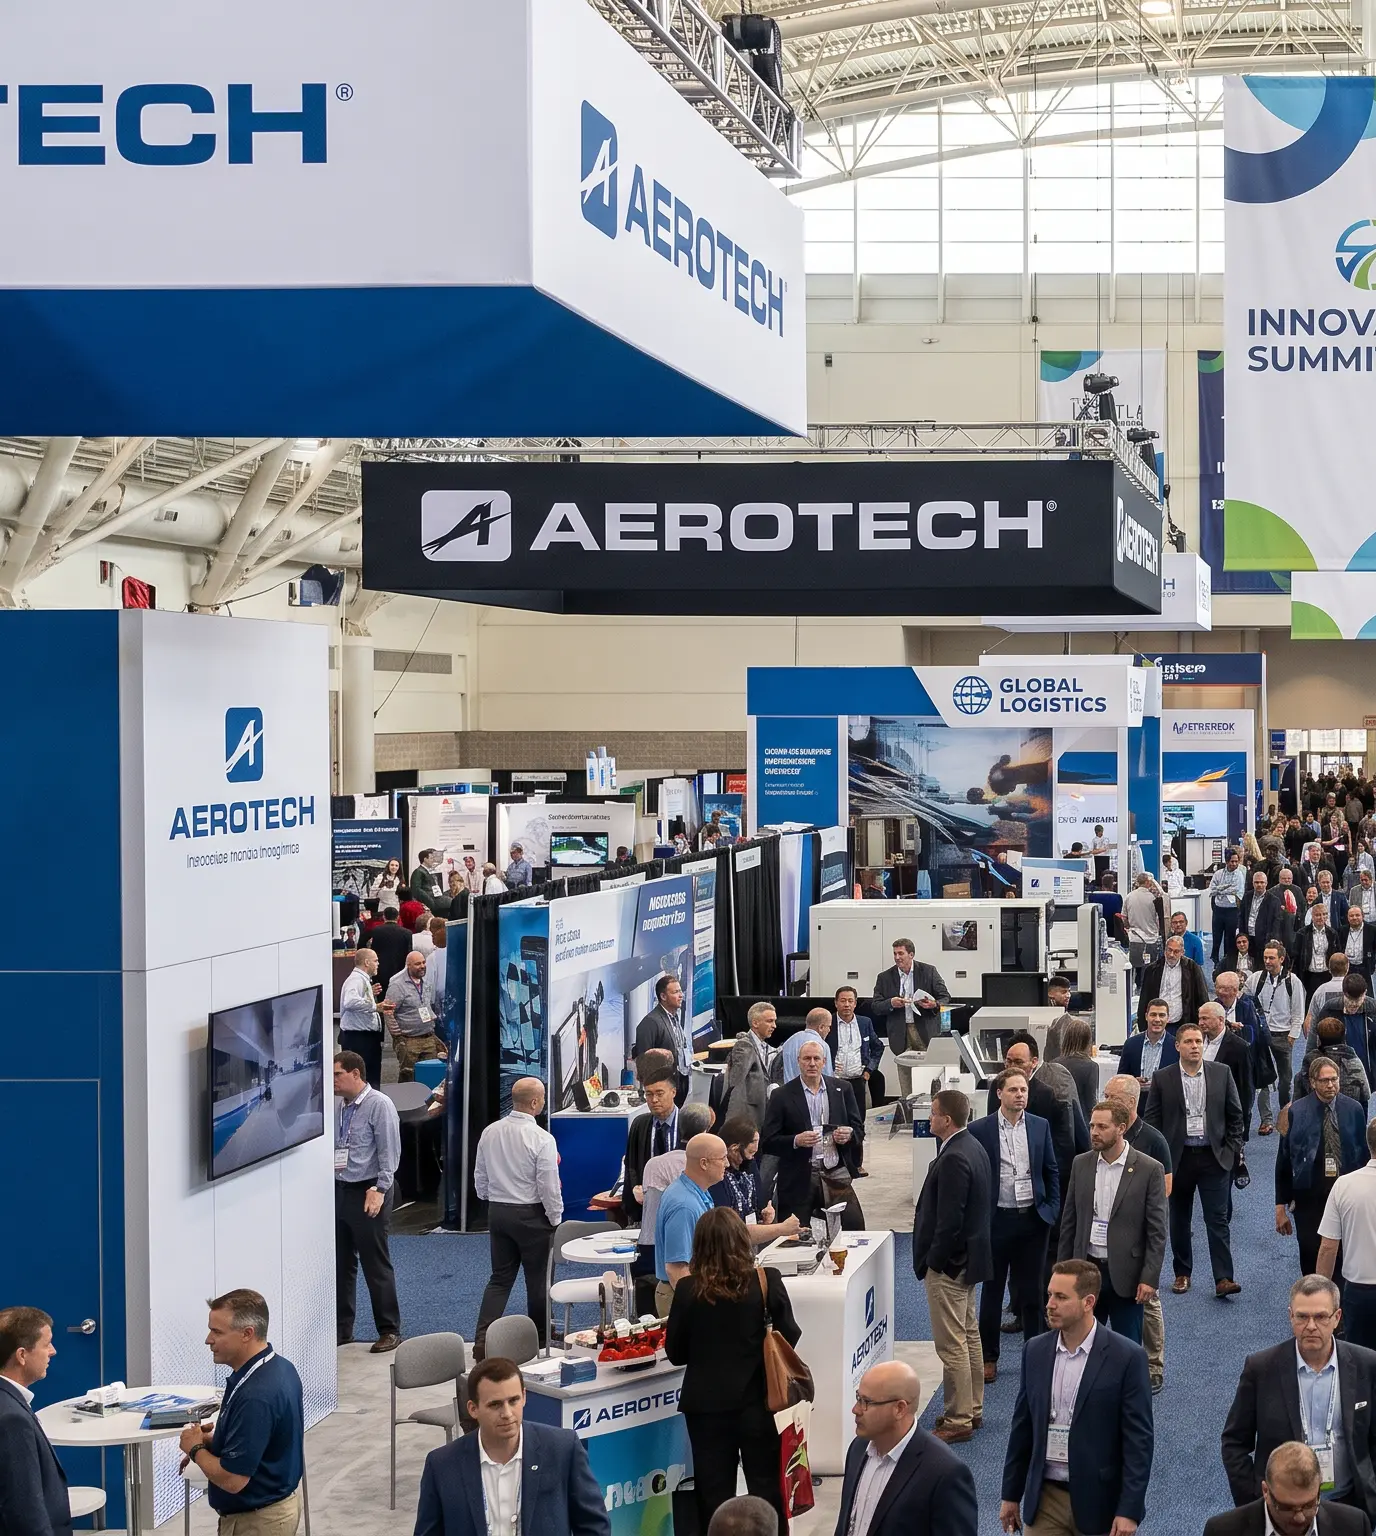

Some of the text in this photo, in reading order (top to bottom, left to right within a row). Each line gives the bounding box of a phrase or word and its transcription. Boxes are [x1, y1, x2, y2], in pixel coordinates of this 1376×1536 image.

[625, 164, 784, 338] AEROTECH
[999, 678, 1083, 693] GLOBAL
[999, 697, 1107, 713] LOGISTICS
[169, 795, 315, 841] AEROTECH
[851, 1314, 888, 1374] AEROTECH
